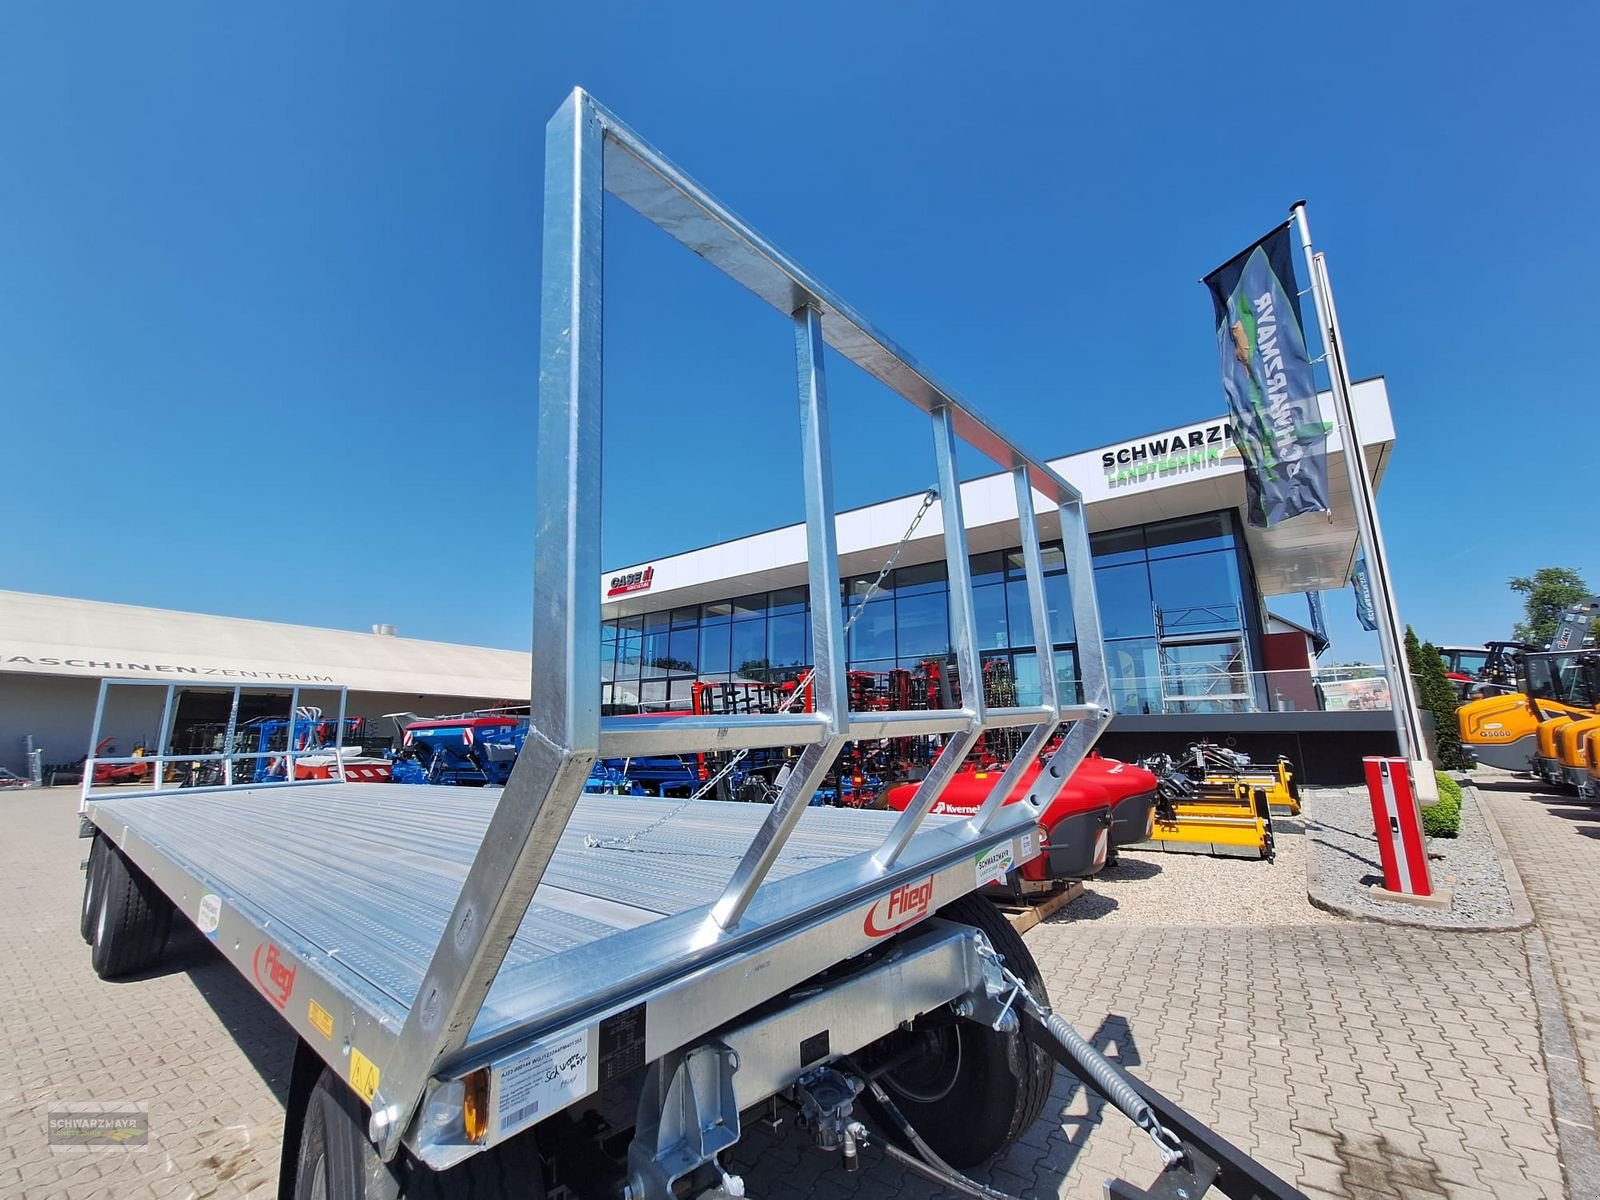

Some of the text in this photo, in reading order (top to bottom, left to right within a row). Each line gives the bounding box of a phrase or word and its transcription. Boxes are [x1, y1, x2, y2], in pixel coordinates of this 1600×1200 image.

[1107, 449, 1219, 481] LANDTECHNIK
[611, 571, 642, 588] CASE
[0, 655, 333, 682] ASCHINENZENTRUM
[1479, 730, 1512, 738] G5000
[946, 803, 981, 814] Kvernel
[978, 849, 1010, 870] SCHWARZMAYR
[886, 872, 935, 922] Fliegl
[263, 943, 297, 1003] Fliegl
